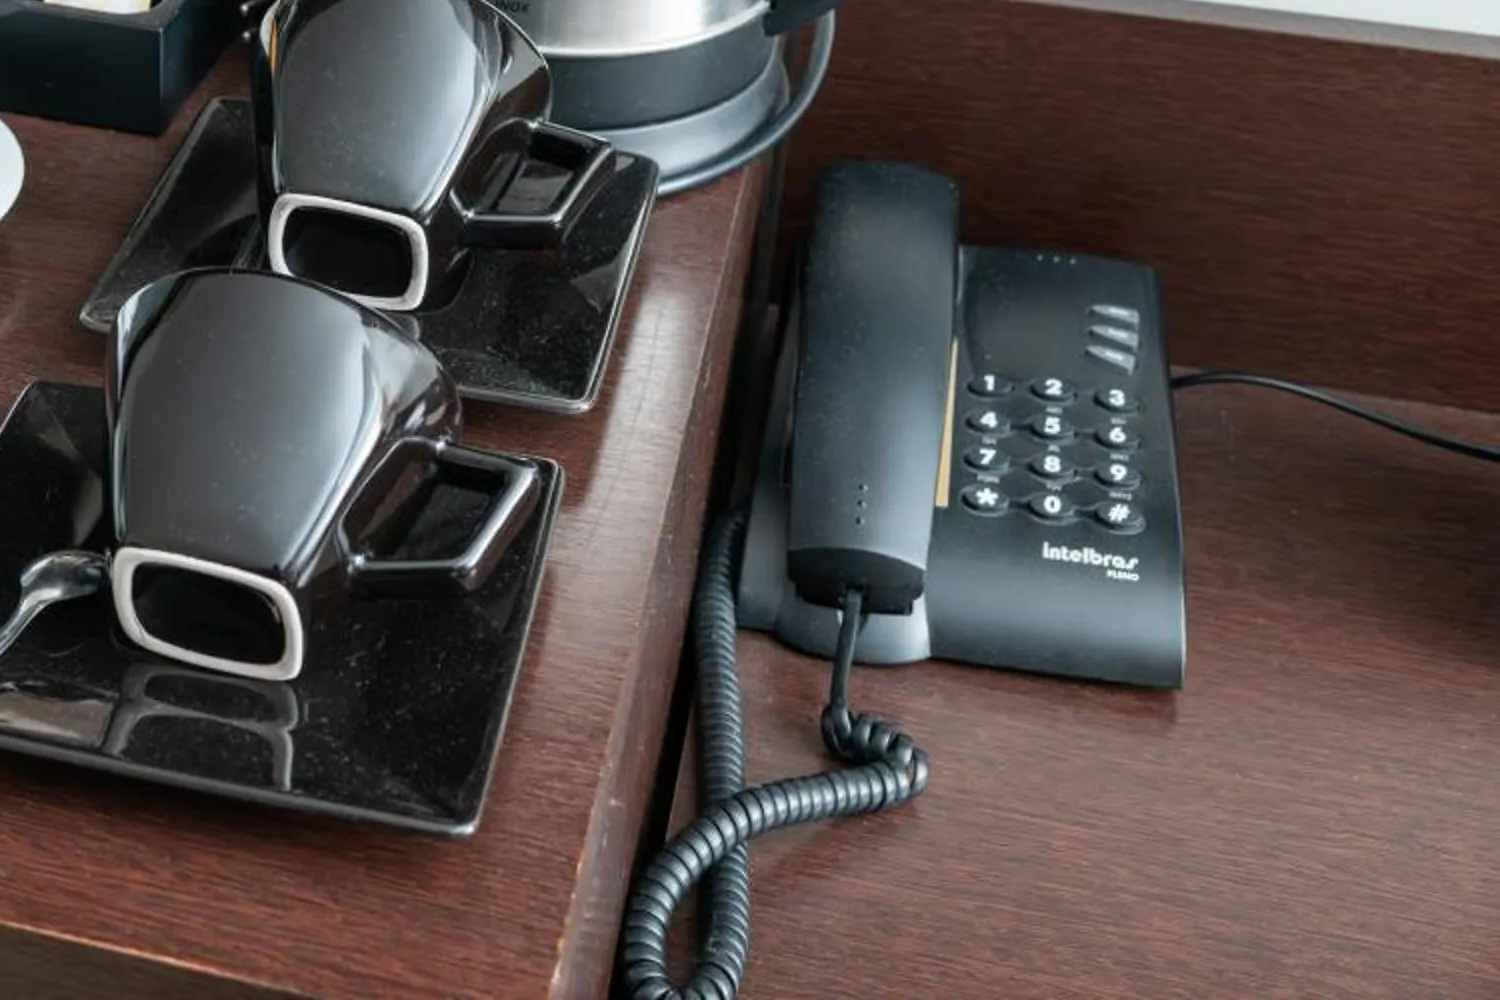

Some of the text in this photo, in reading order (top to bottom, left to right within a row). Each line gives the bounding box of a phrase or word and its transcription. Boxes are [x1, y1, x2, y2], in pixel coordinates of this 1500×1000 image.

[983, 375, 1126, 406] 1 2 3
[979, 411, 1126, 443] 4 5 6
[979, 448, 1127, 481] 7 8 9
[1043, 495, 1062, 514] 0
